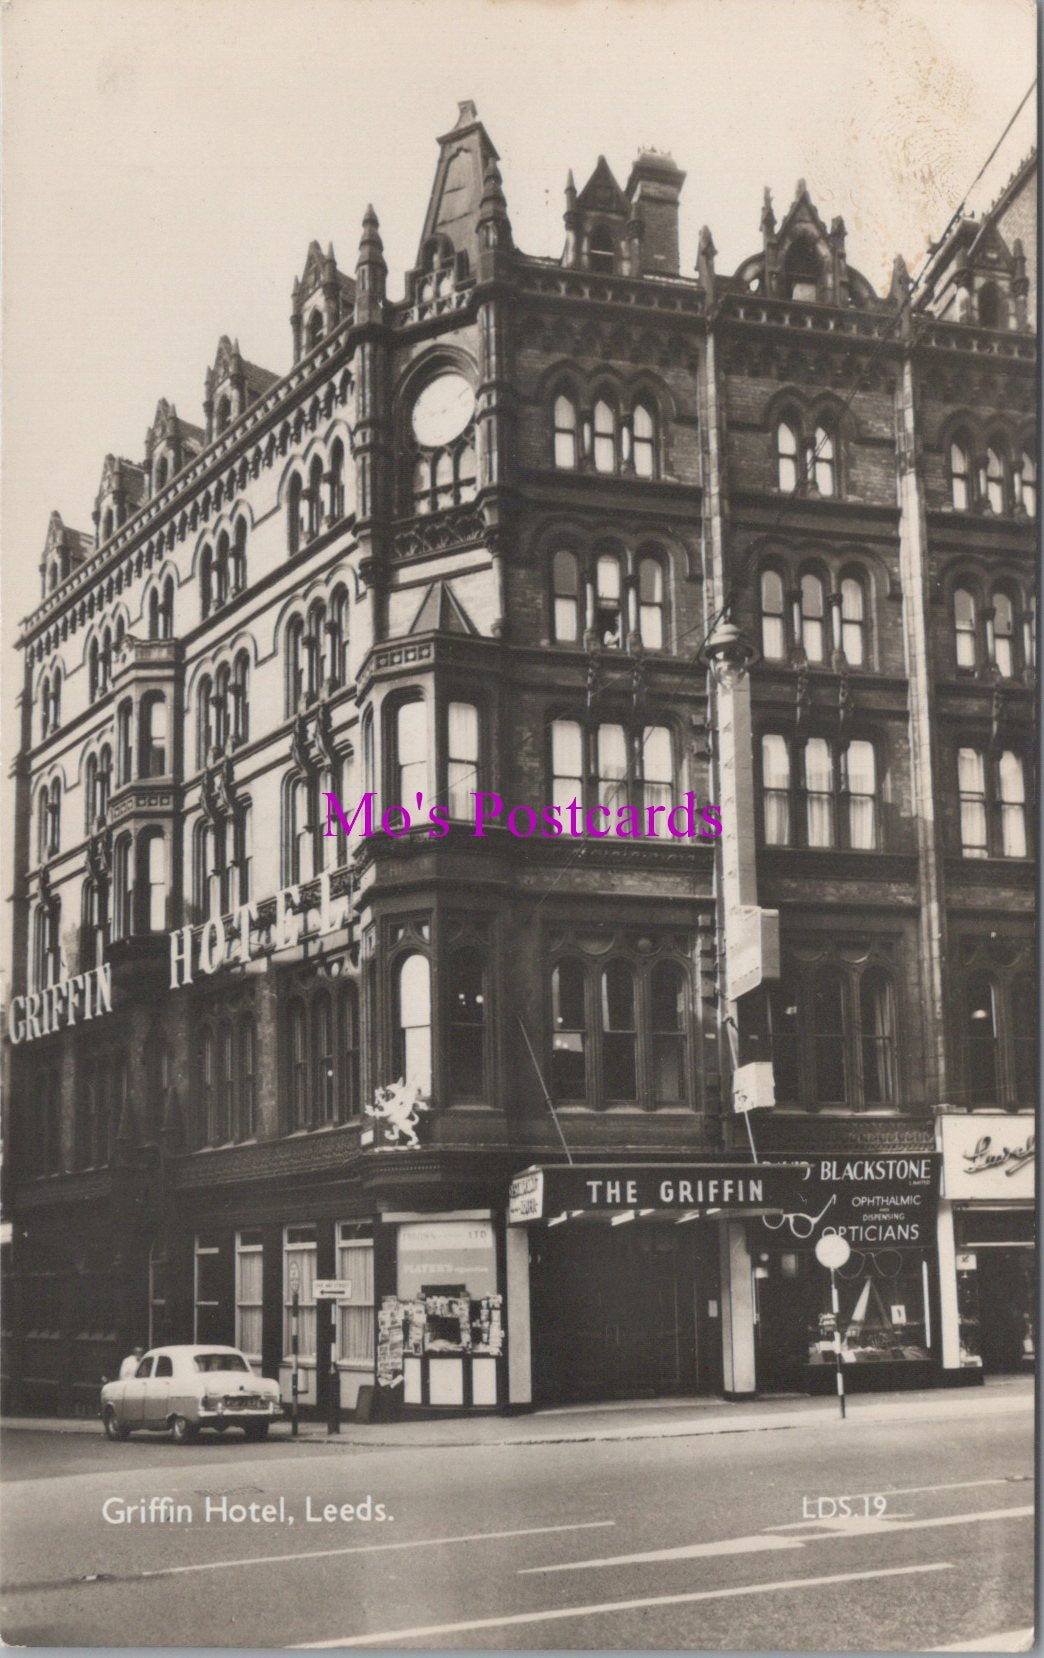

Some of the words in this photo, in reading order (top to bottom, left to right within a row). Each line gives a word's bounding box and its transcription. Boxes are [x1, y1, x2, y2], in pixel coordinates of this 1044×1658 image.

[8, 962, 113, 1045] GRIFFIN
[169, 872, 349, 990] HOTEL
[820, 1159, 932, 1181] BLACKSTONE
[586, 1180, 638, 1204] THE
[659, 1179, 764, 1203] GRIFFIN
[851, 1194, 922, 1208] OPHTHALMIC
[862, 1212, 906, 1221] DISPENSING
[468, 1229, 487, 1239] LTD
[822, 1223, 920, 1242] OPTICIANS
